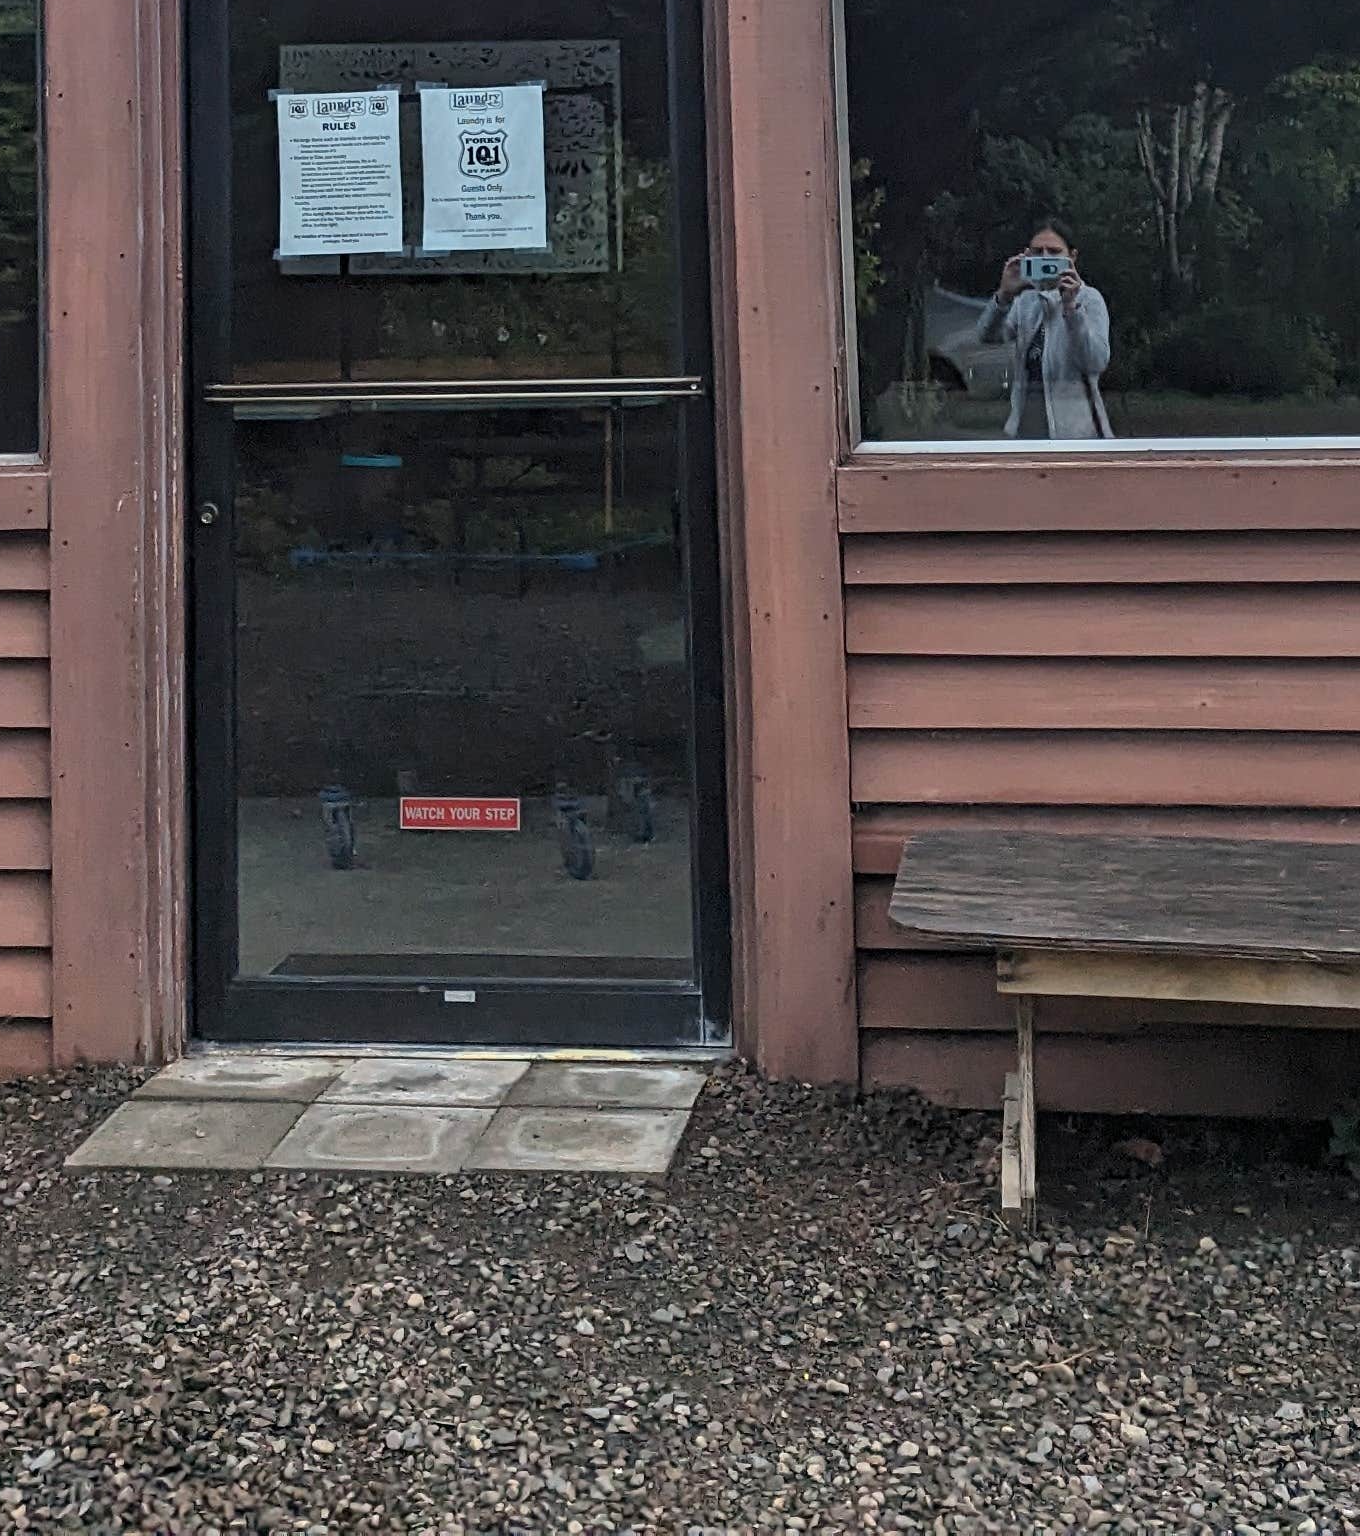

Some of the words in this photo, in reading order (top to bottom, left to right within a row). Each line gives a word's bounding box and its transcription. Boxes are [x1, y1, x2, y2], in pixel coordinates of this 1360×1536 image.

[452, 92, 500, 108] Laundry
[316, 99, 364, 115] Laundry
[322, 121, 356, 131] RULES
[457, 117, 485, 126] Laundry
[495, 115, 505, 123] for
[467, 145, 501, 166] 101
[461, 184, 485, 192] Guests
[465, 212, 486, 221] Thank
[404, 806, 445, 820] WATCH
[450, 806, 480, 820] YOUR
[485, 806, 516, 820] STEP
